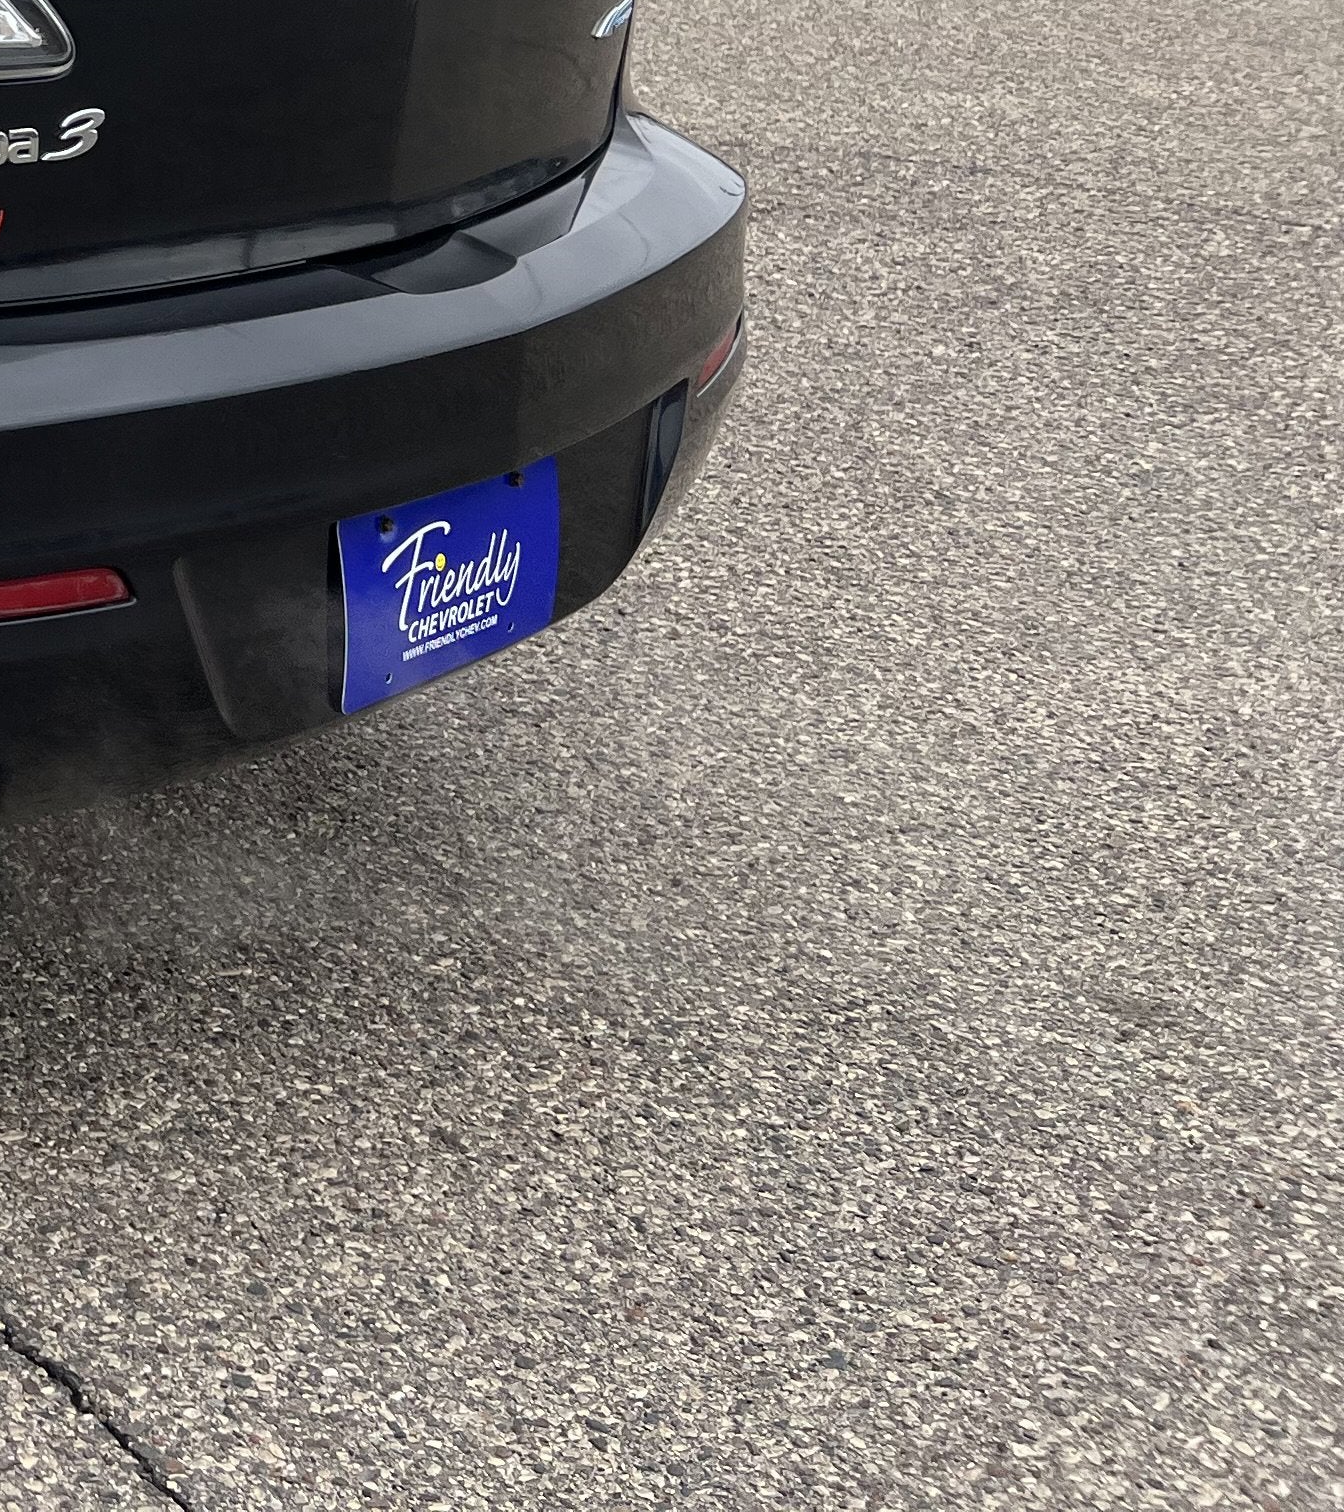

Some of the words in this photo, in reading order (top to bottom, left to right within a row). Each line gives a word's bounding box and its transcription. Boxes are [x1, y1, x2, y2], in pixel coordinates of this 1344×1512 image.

[41, 107, 106, 161] 3
[381, 520, 521, 631] Friendly
[402, 614, 498, 662] WWW.FRIENDLYCHEV.COM
[408, 590, 495, 643] CHEVROLET
